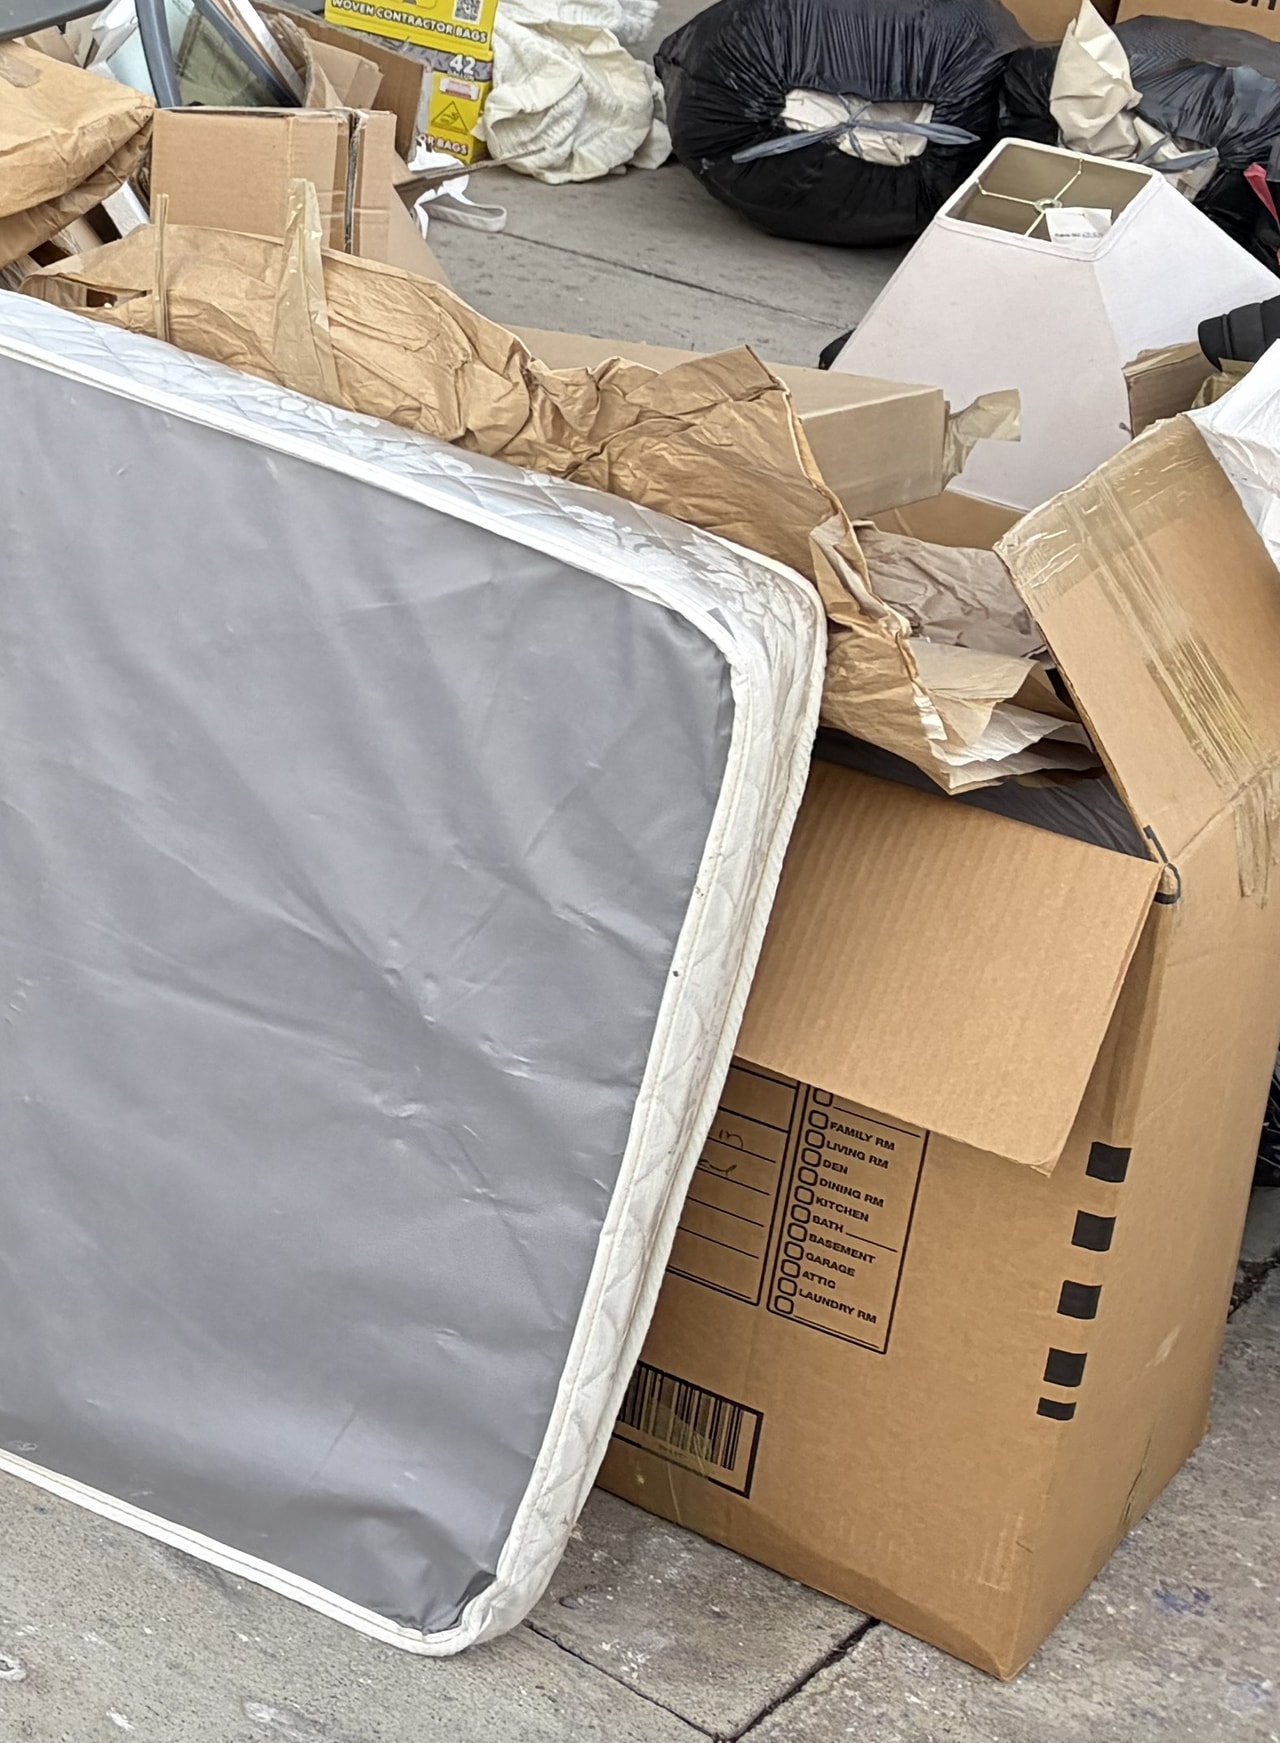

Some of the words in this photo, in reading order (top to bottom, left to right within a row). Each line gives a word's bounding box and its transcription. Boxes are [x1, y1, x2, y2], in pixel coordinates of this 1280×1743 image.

[375, 6, 454, 36] CONTRACTOR
[454, 23, 489, 44] BAGS
[448, 54, 477, 77] 42
[435, 136, 469, 157] BAGS
[829, 1121, 874, 1144] FAMILY
[874, 1136, 896, 1151] RM
[822, 1158, 849, 1174] DEN
[826, 1140, 866, 1161] LIVING
[868, 1154, 889, 1170] RM
[819, 1177, 862, 1200] DINING
[864, 1192, 885, 1208] RM
[815, 1196, 870, 1223] KITCHEN
[812, 1215, 845, 1234] BATH
[808, 1234, 877, 1264] BASEMENT
[805, 1252, 857, 1278] GARAGE
[801, 1270, 837, 1290] ATTIC
[799, 1288, 856, 1316] LAUNDRY
[857, 1309, 878, 1325] RM
